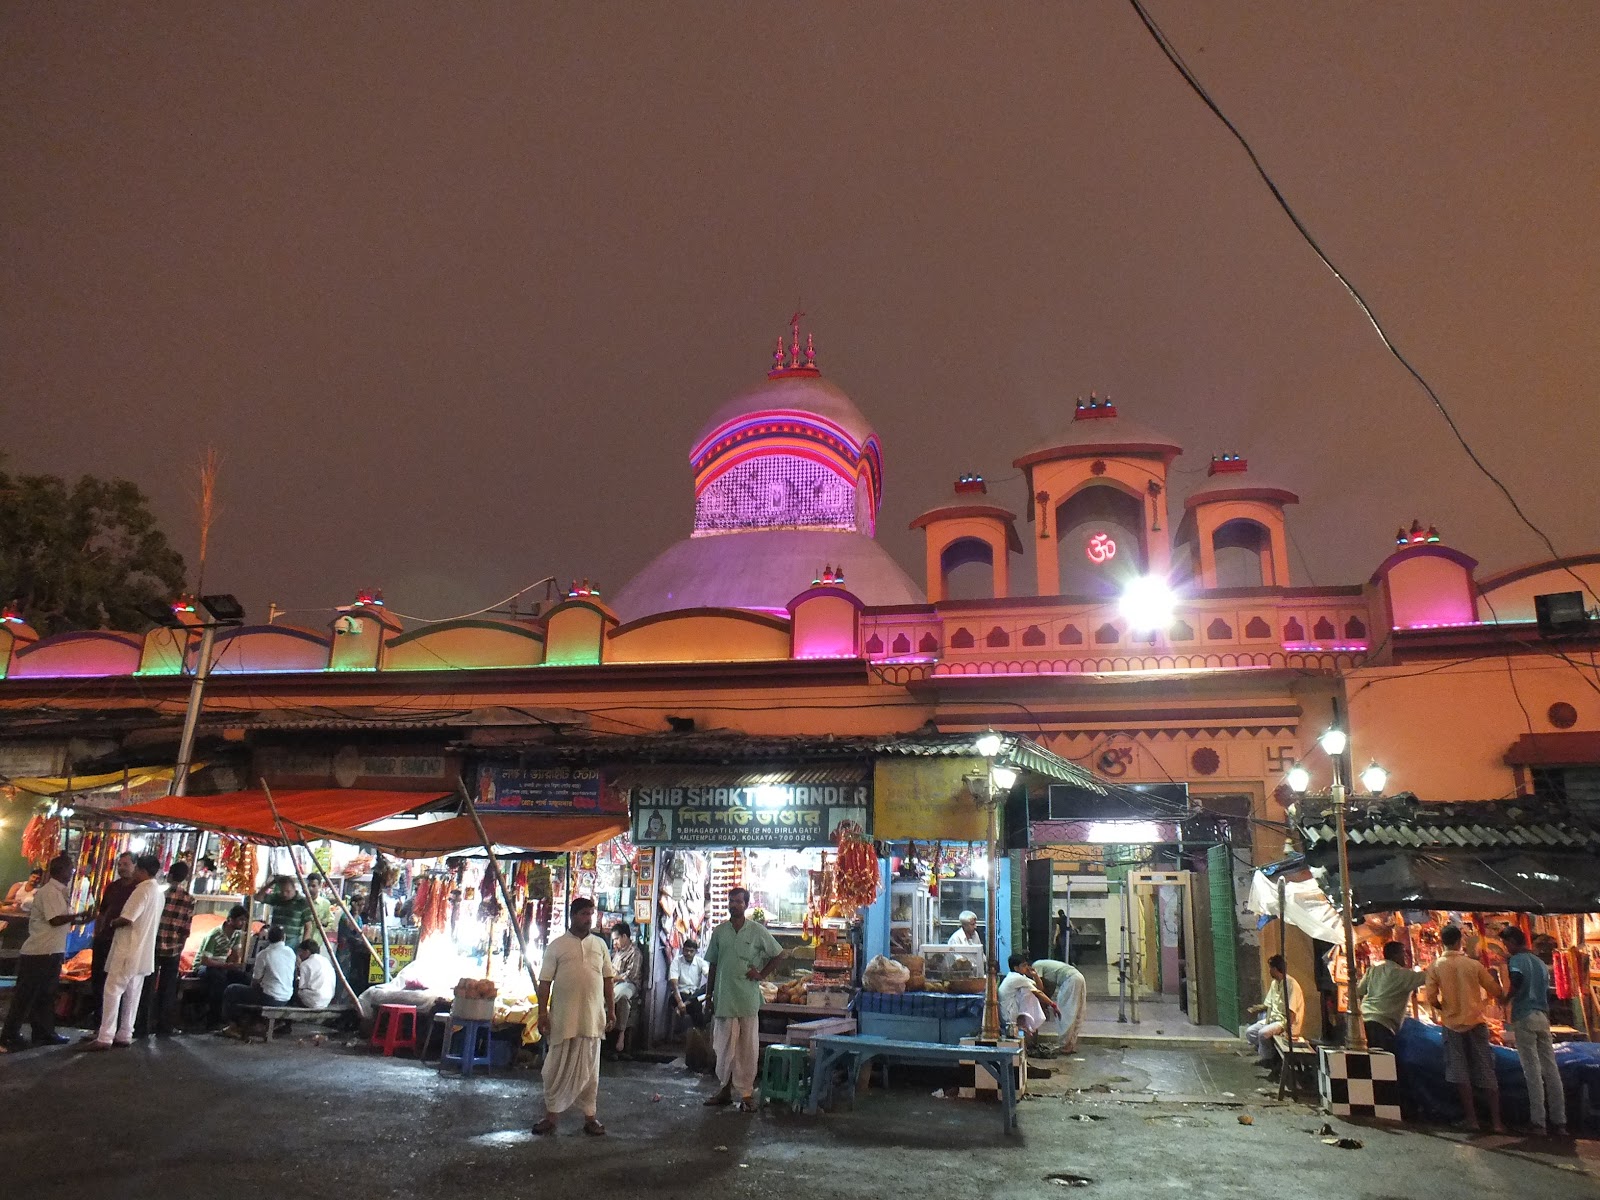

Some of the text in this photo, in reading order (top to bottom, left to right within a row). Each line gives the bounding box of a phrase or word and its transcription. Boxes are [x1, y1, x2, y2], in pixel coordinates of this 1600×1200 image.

[638, 788, 683, 806] SHIB
[687, 787, 763, 806] SHAKT
[678, 806, 712, 825] শিব
[714, 806, 753, 825] শক্তি
[774, 827, 798, 835] BIRLA
[798, 826, 821, 835] GATE)
